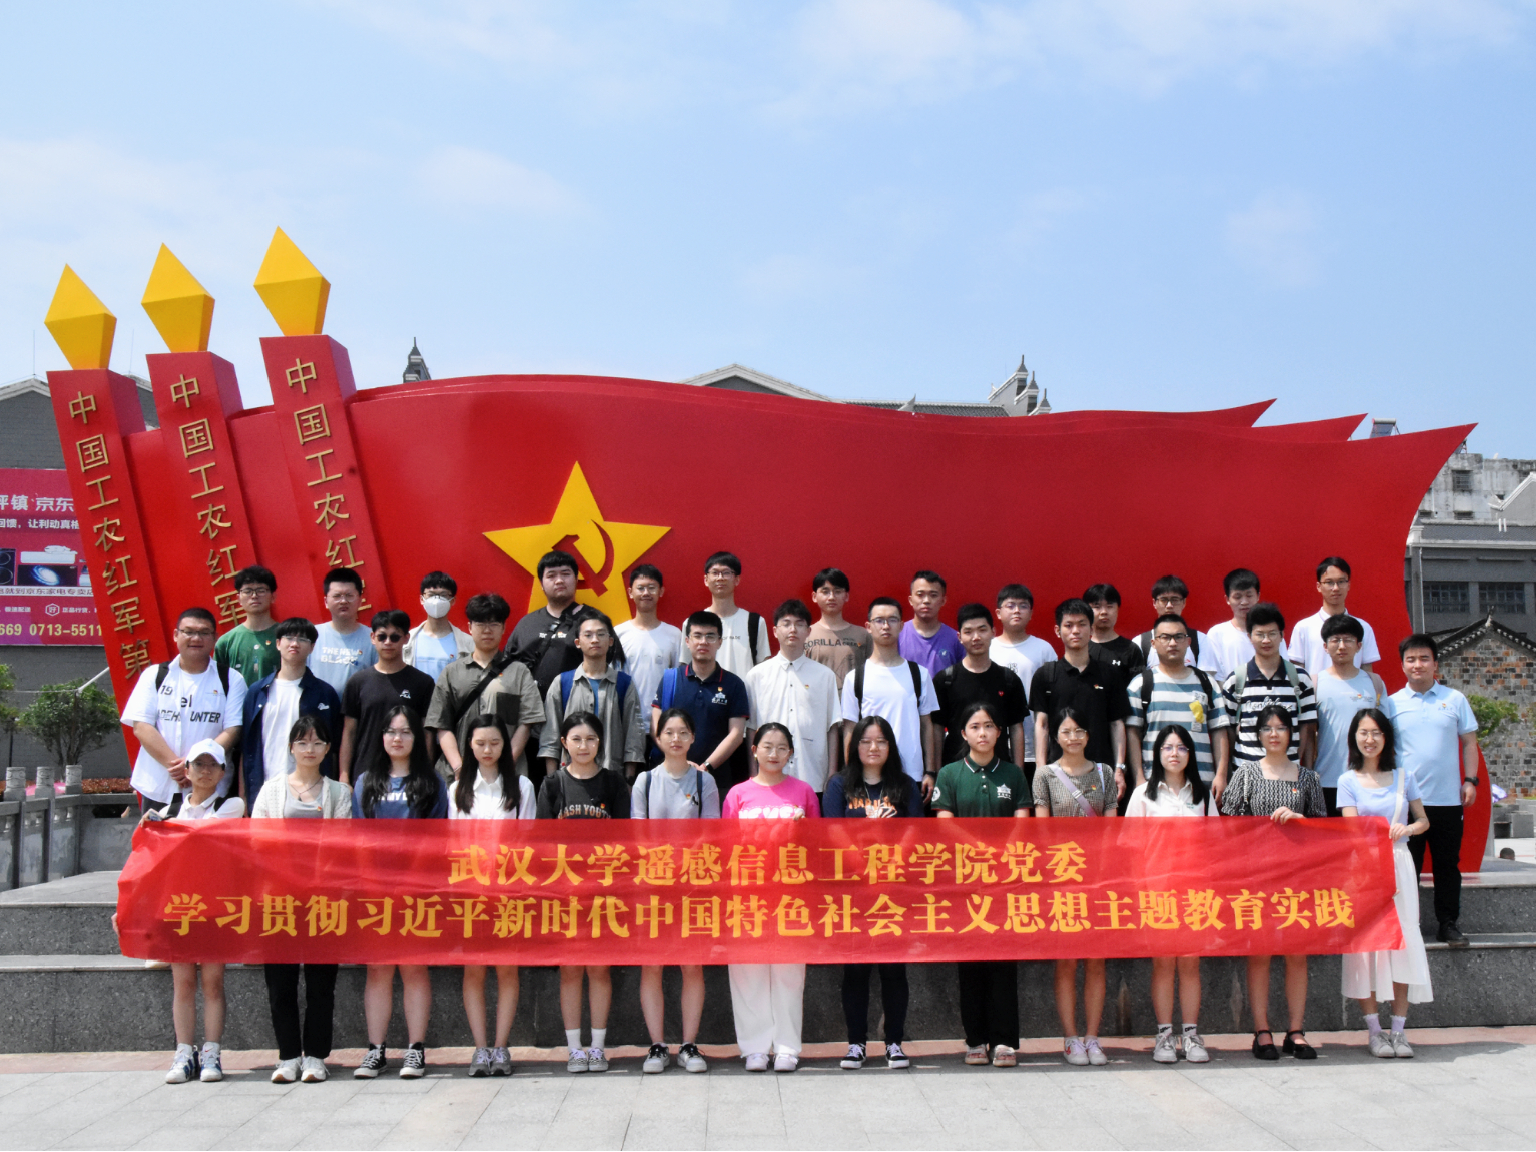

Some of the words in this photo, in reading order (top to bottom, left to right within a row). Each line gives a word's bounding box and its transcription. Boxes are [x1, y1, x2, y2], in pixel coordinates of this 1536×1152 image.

[35, 495, 74, 512] 京东
[169, 373, 247, 628] 中国工农红军
[68, 390, 154, 680] 中国工农红军第
[322, 647, 339, 655] THE
[803, 638, 842, 649] GORILLA
[190, 711, 221, 723] UNTER
[447, 841, 1087, 887] 武汉大学遥感信息工程学院党委
[163, 888, 1355, 938] 学习贯彻习近平新时代中国特色社会主义思想主题教育实践
